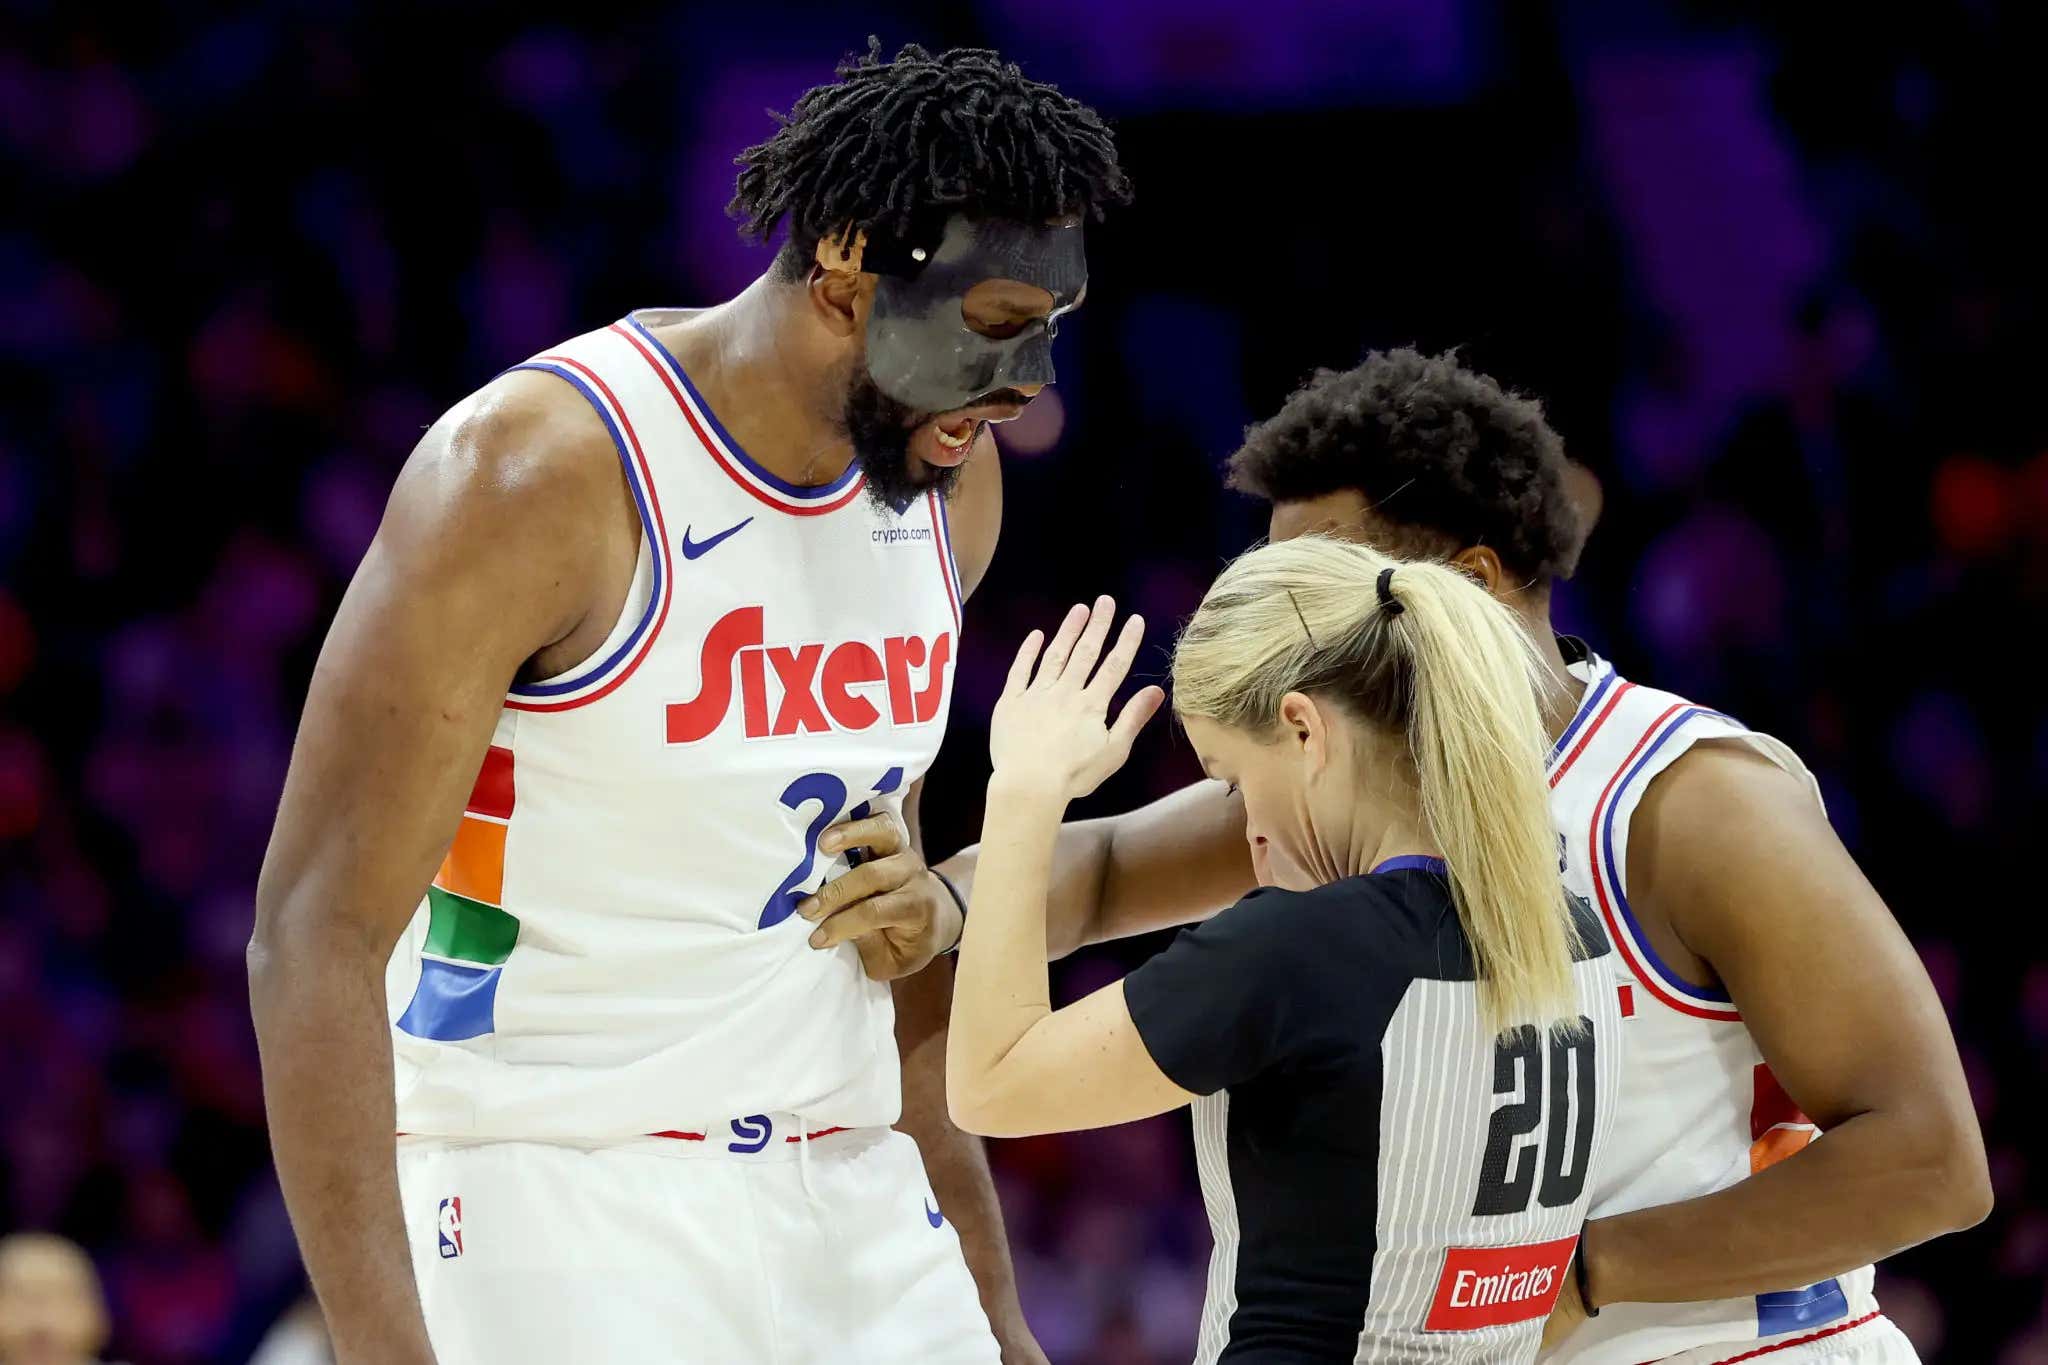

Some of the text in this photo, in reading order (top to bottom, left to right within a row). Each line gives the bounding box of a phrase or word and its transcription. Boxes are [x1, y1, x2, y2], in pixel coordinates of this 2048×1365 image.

[871, 528, 931, 544] crypto.com
[665, 605, 950, 744] Sixers
[1471, 1014, 1596, 1217] 20
[1449, 1264, 1557, 1308] Emirates
